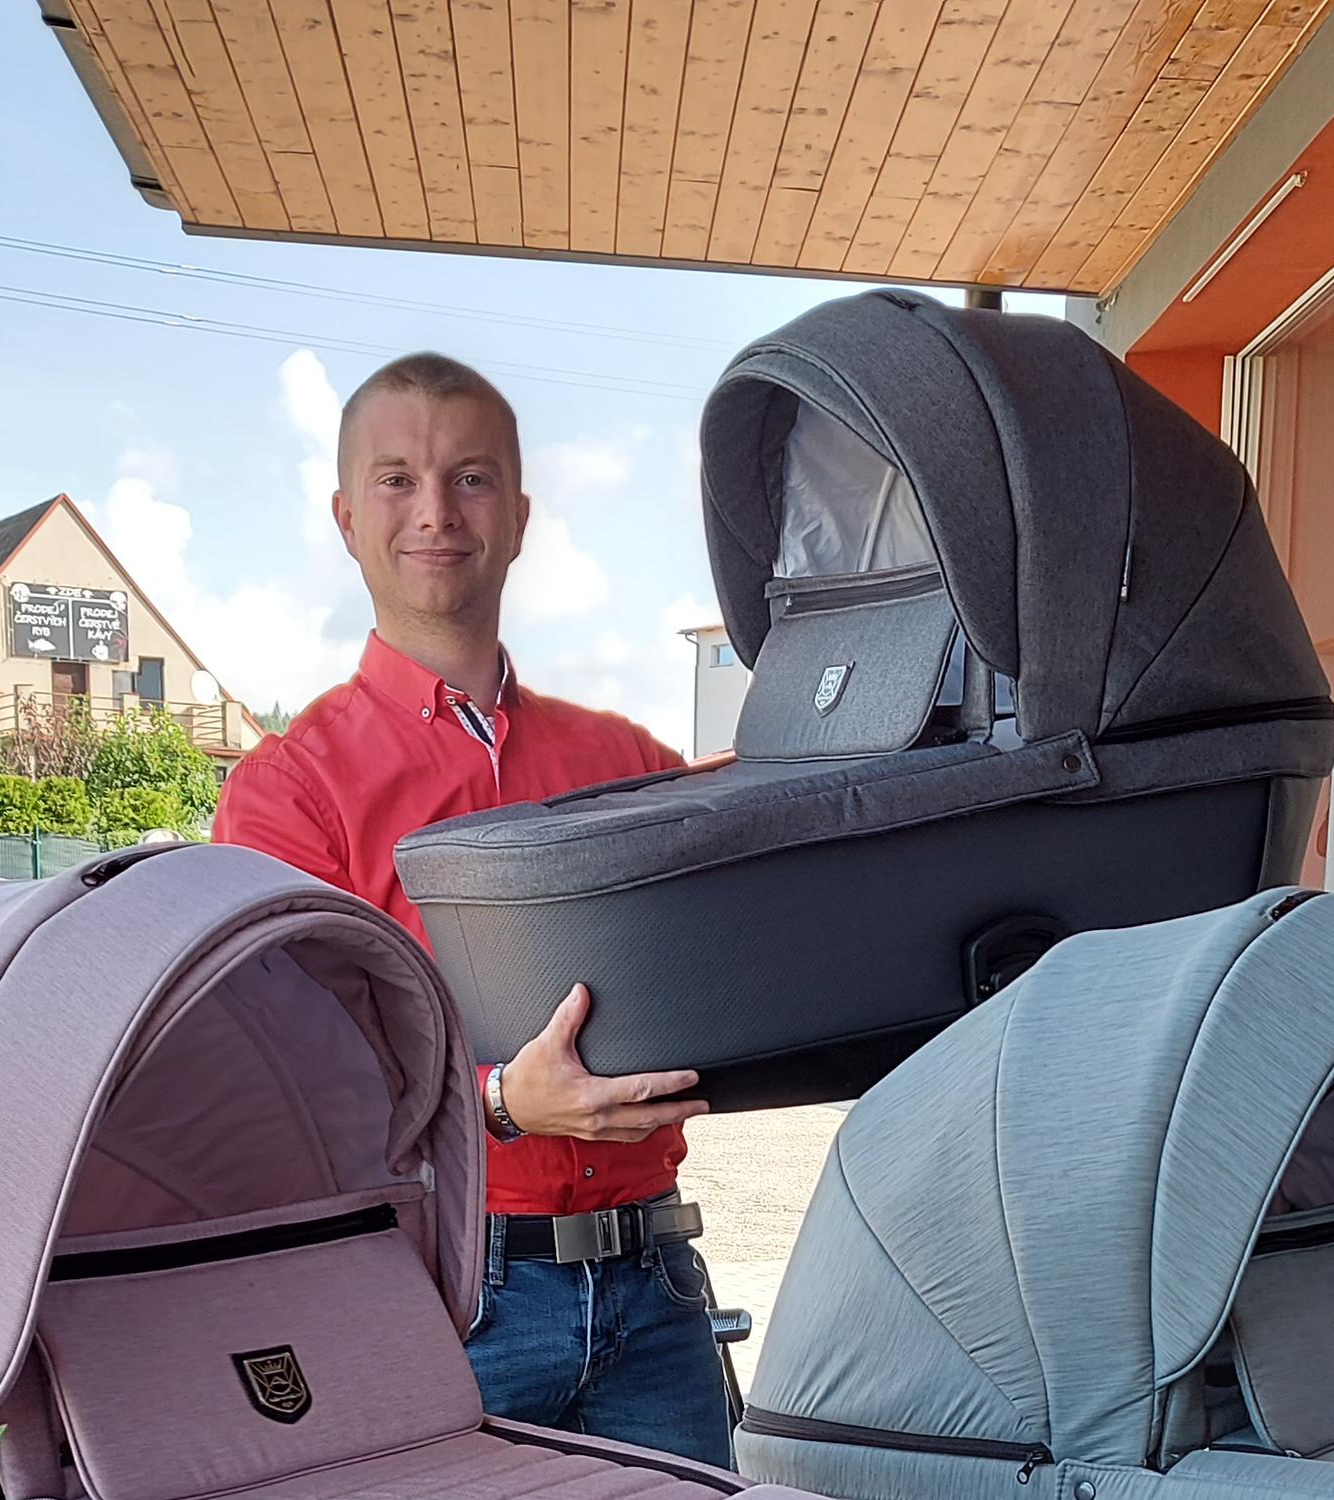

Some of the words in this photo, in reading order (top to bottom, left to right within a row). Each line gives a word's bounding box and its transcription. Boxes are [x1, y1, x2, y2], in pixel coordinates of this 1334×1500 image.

[58, 587, 83, 598] ZDE
[21, 603, 60, 615] PRODEJ
[79, 606, 119, 619] PRODEJ
[32, 626, 51, 637] RYB
